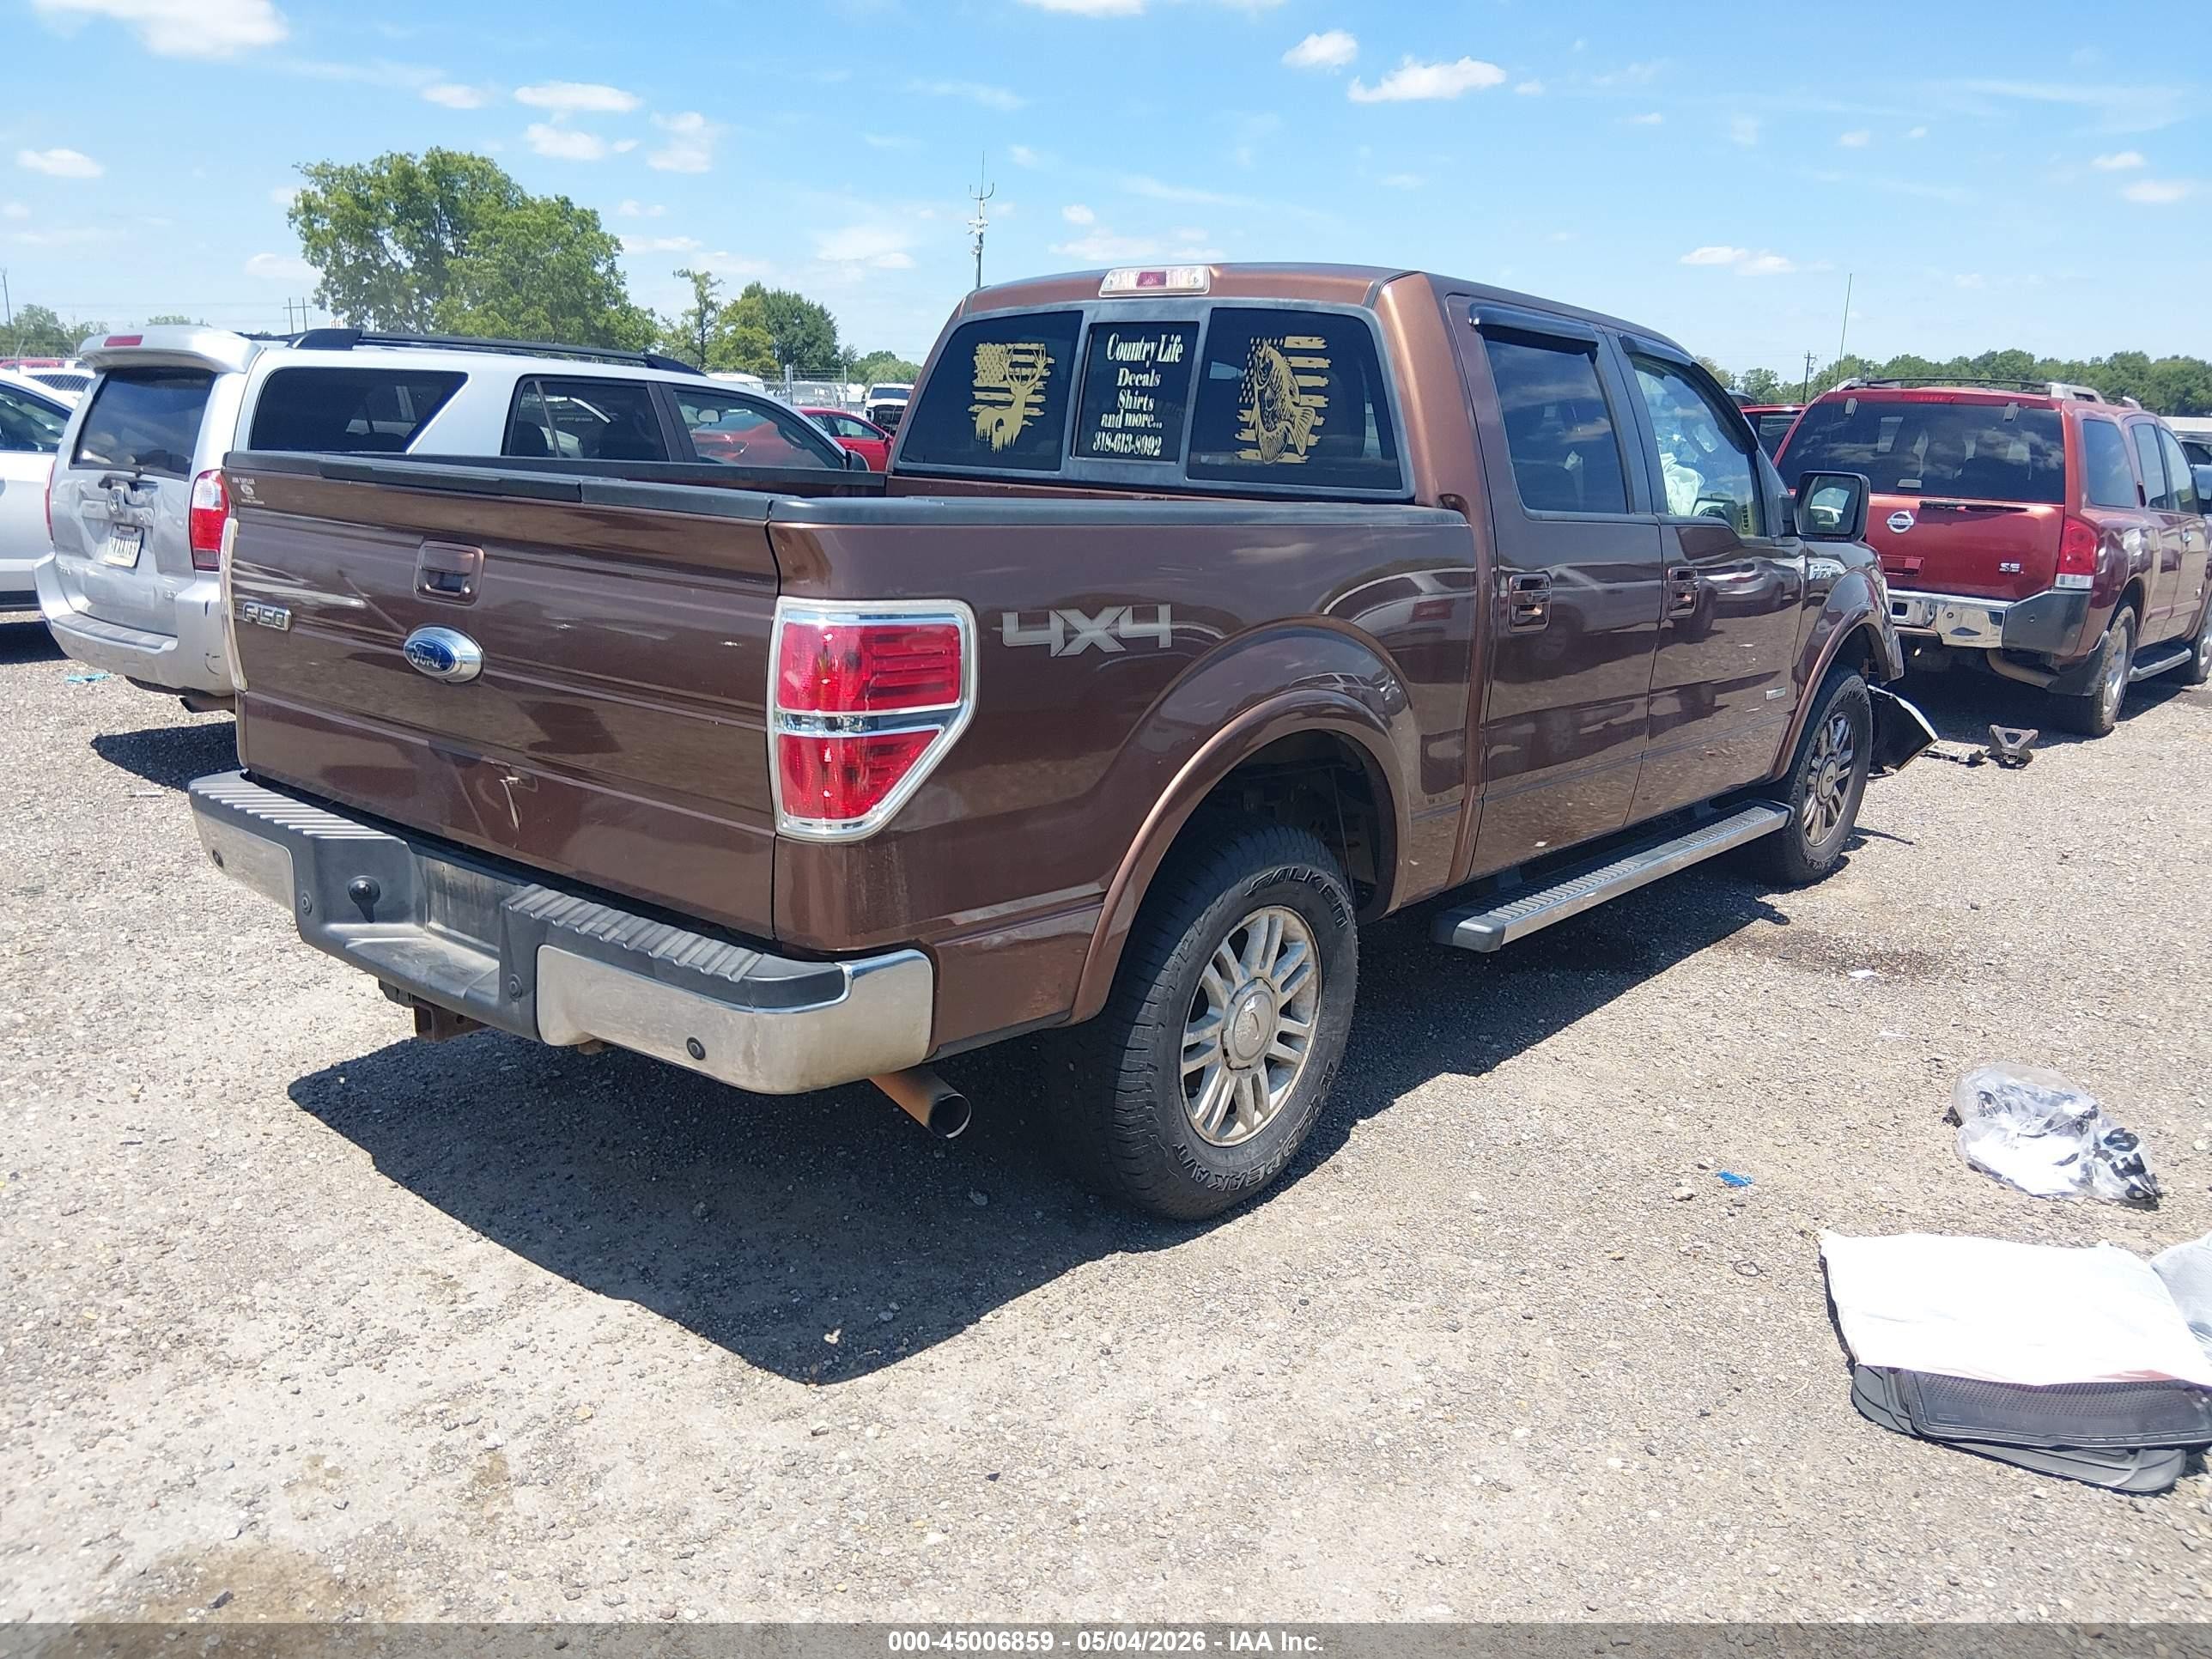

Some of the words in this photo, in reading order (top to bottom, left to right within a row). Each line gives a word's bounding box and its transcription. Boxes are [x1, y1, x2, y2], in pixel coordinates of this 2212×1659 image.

[1106, 332, 1158, 368] Country
[1156, 334, 1183, 363] Life
[1117, 368, 1161, 387] Decals
[1117, 389, 1155, 411] Shirts
[1100, 409, 1123, 428] and
[1124, 412, 1163, 429] more...
[1999, 562, 2021, 572] SE
[410, 641, 443, 669] Ford
[1243, 866, 1348, 928] FALKEN
